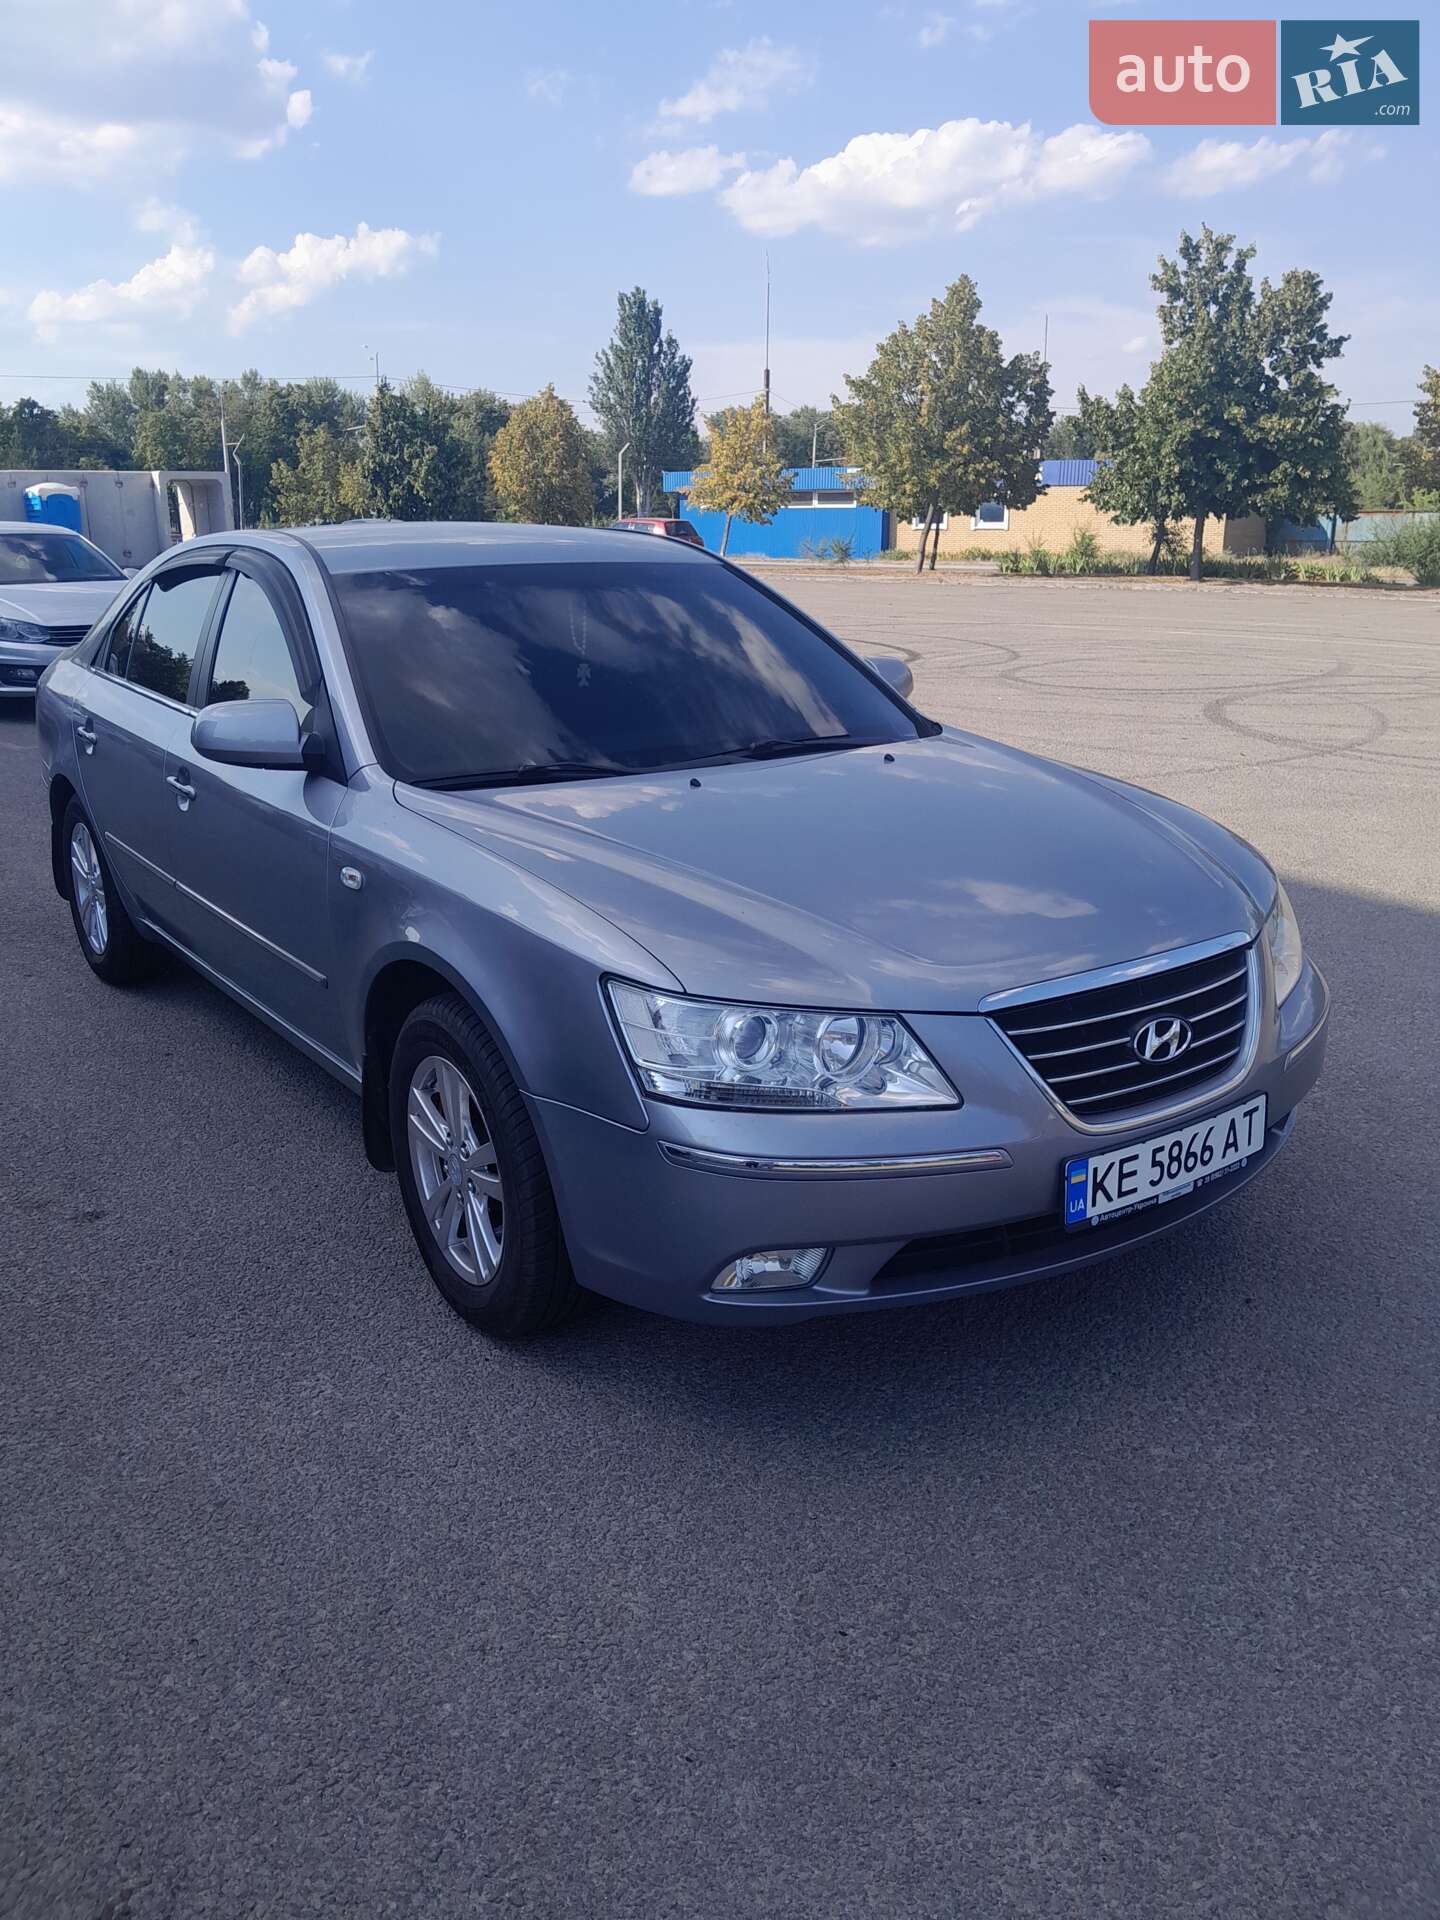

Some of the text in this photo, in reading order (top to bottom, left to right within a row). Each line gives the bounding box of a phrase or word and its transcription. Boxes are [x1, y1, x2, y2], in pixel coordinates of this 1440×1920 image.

[1091, 1154, 1140, 1208] KE
[1149, 1126, 1215, 1187] 5866
[1222, 1105, 1260, 1159] AT
[1069, 1199, 1085, 1213] UA
